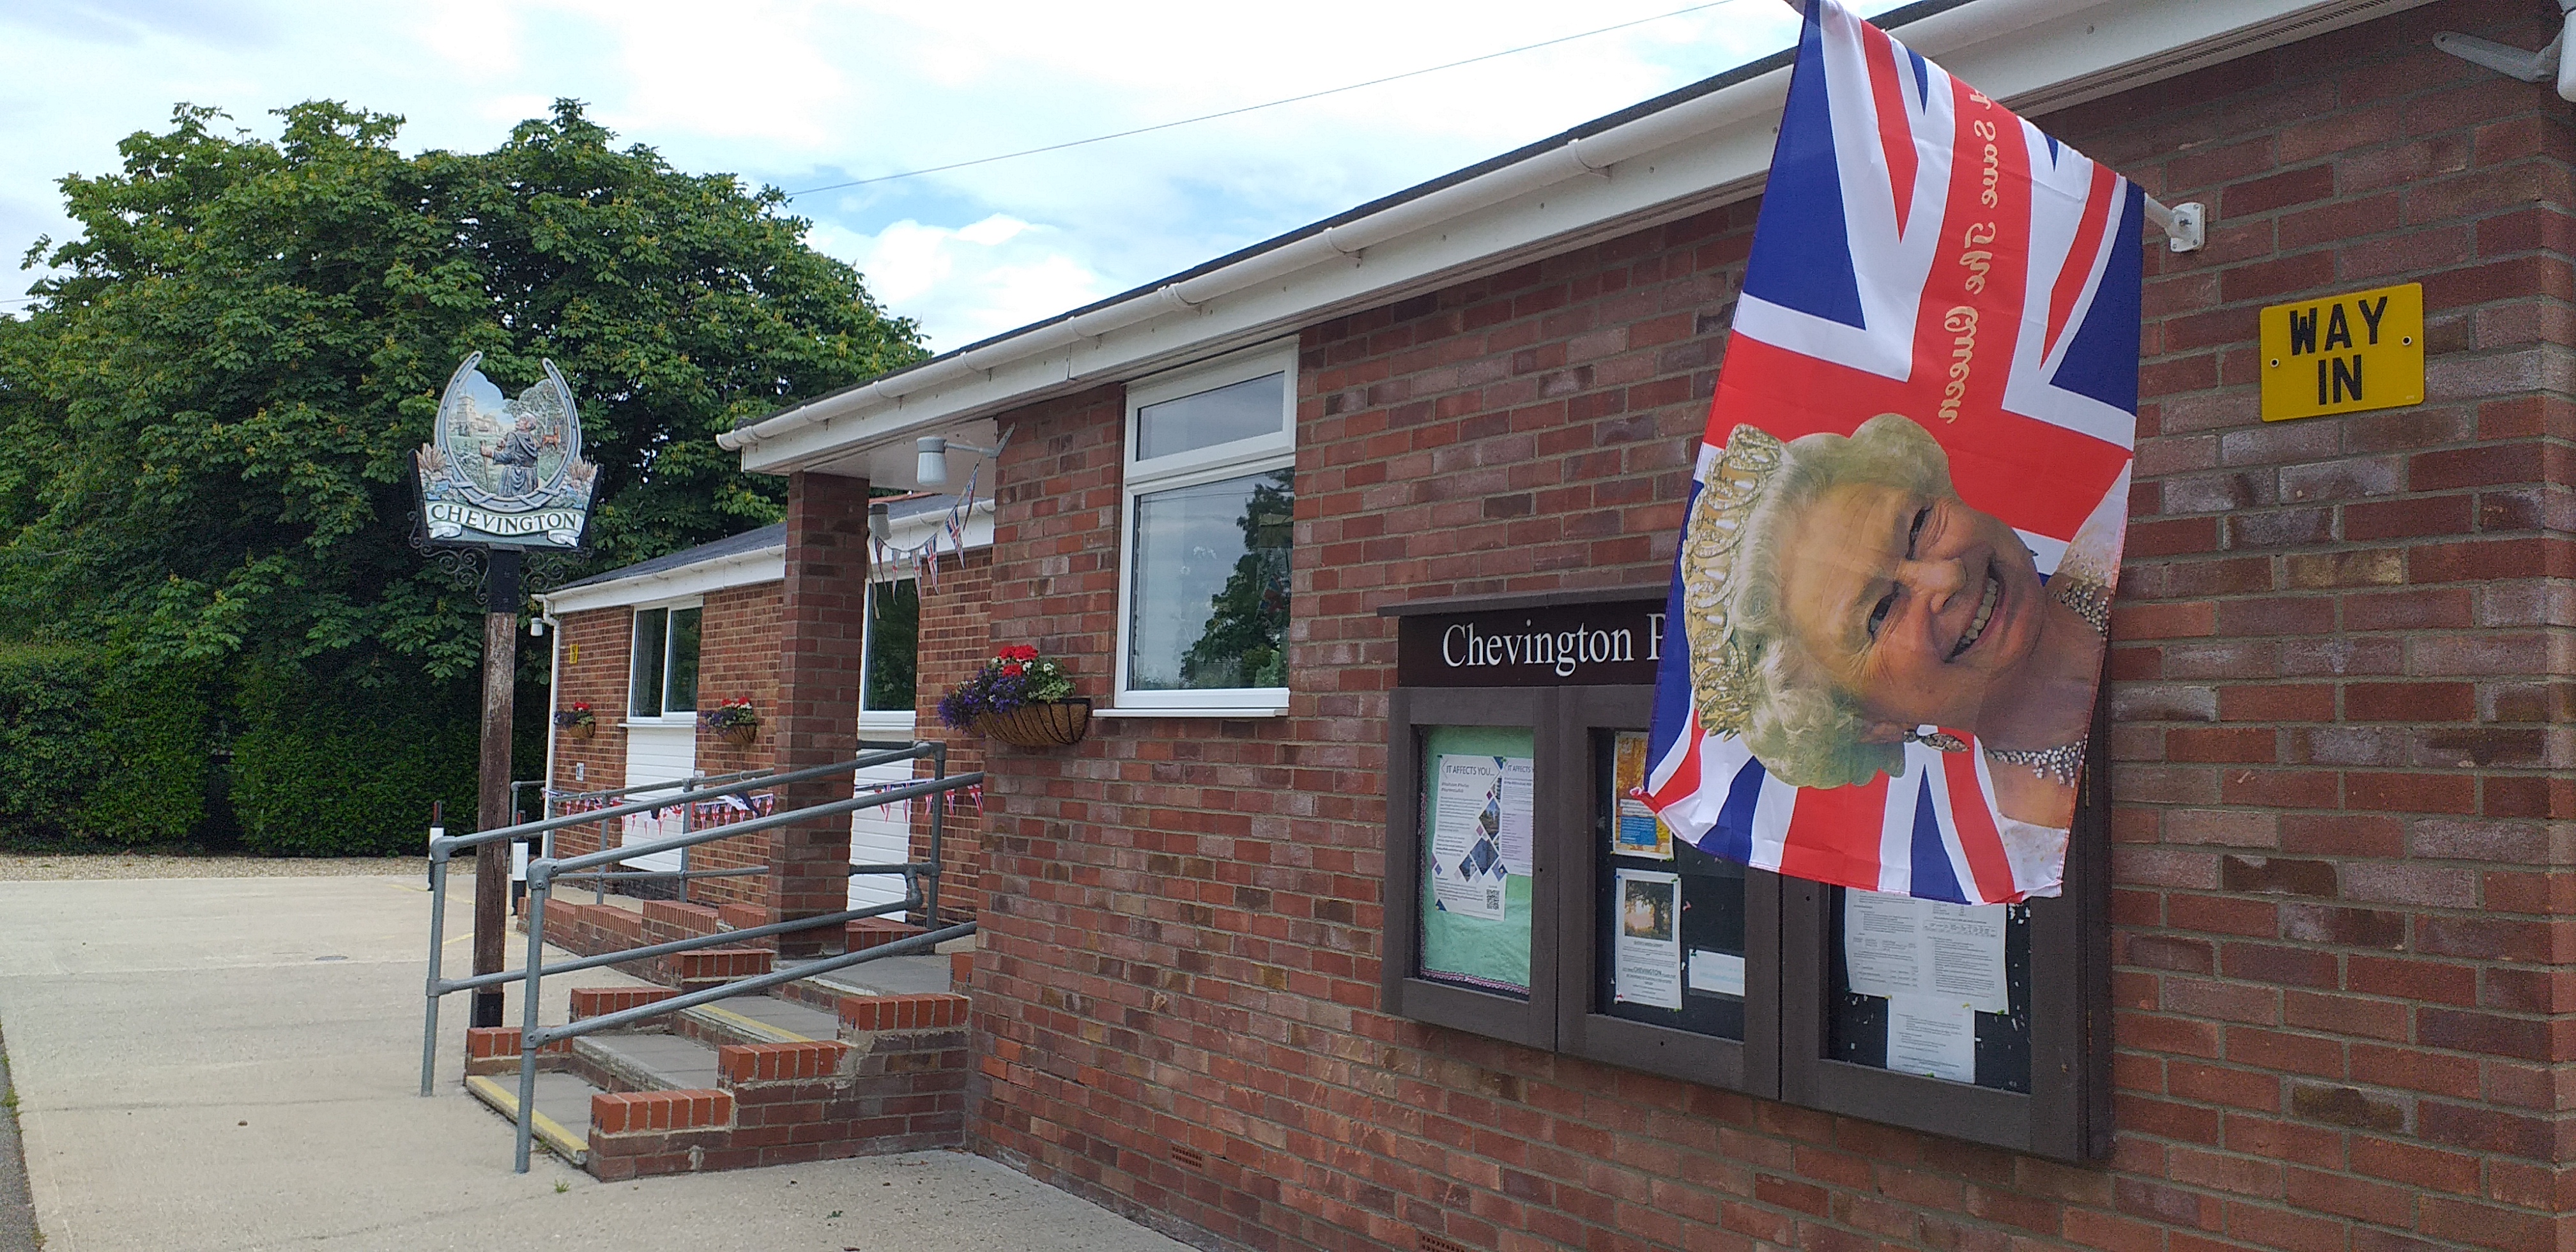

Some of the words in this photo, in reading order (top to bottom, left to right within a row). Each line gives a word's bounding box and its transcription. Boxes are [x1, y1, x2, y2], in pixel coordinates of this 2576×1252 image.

[2289, 296, 2388, 356] WAY
[2318, 355, 2363, 406] IN
[431, 504, 576, 533] CHEVINGTON
[1443, 618, 1635, 677] Chevington
[1446, 765, 1452, 774] IT
[1453, 765, 1476, 775] AFFECTS
